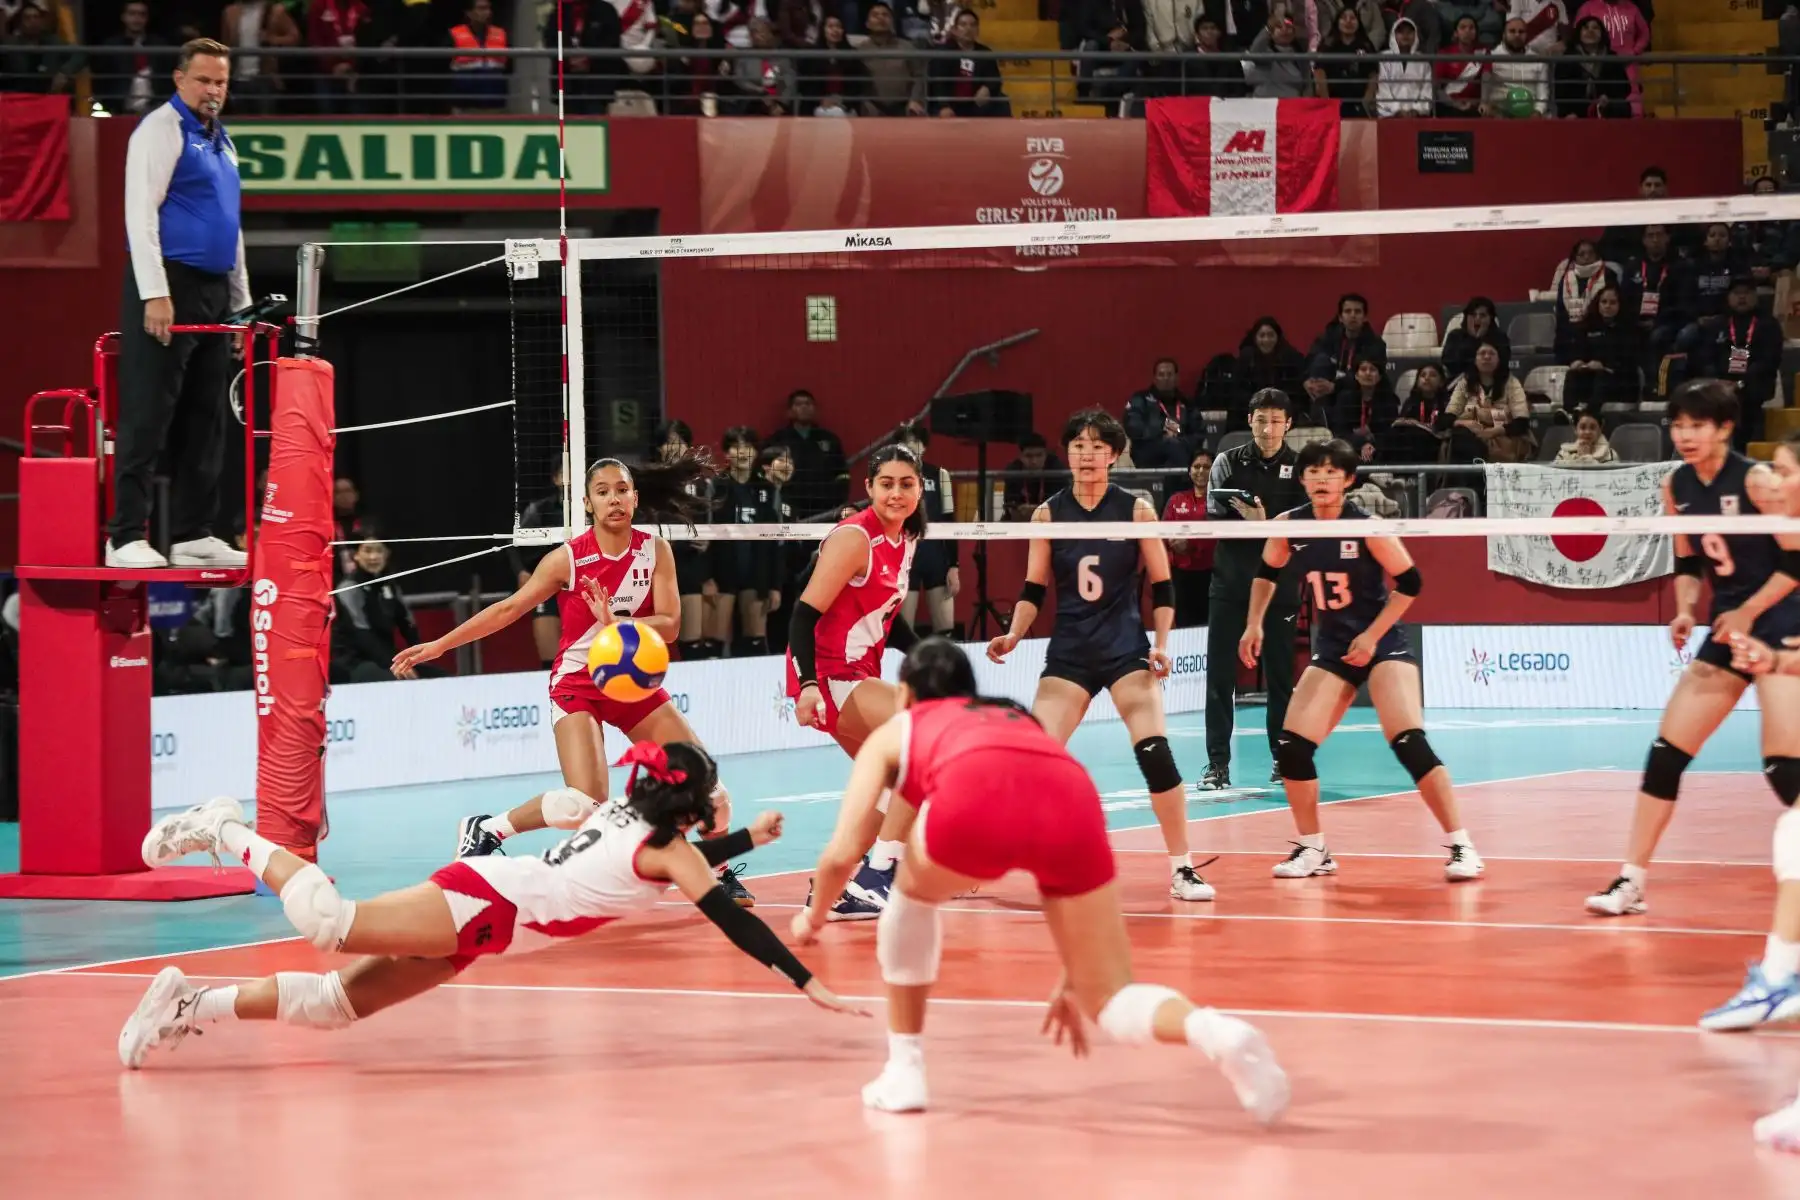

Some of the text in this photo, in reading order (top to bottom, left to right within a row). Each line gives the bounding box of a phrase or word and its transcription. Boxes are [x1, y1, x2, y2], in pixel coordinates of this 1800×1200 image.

[230, 133, 572, 181] SALIDA
[1025, 136, 1065, 152] FIVB
[1020, 197, 1072, 207] VOLLEYBALL
[1027, 207, 1058, 221] U17
[1062, 206, 1118, 221] WORLD
[1701, 533, 1736, 577] 9
[632, 579, 650, 587] PER
[1077, 554, 1104, 602] 6
[1305, 570, 1353, 611] 13
[253, 609, 275, 716] Senoh
